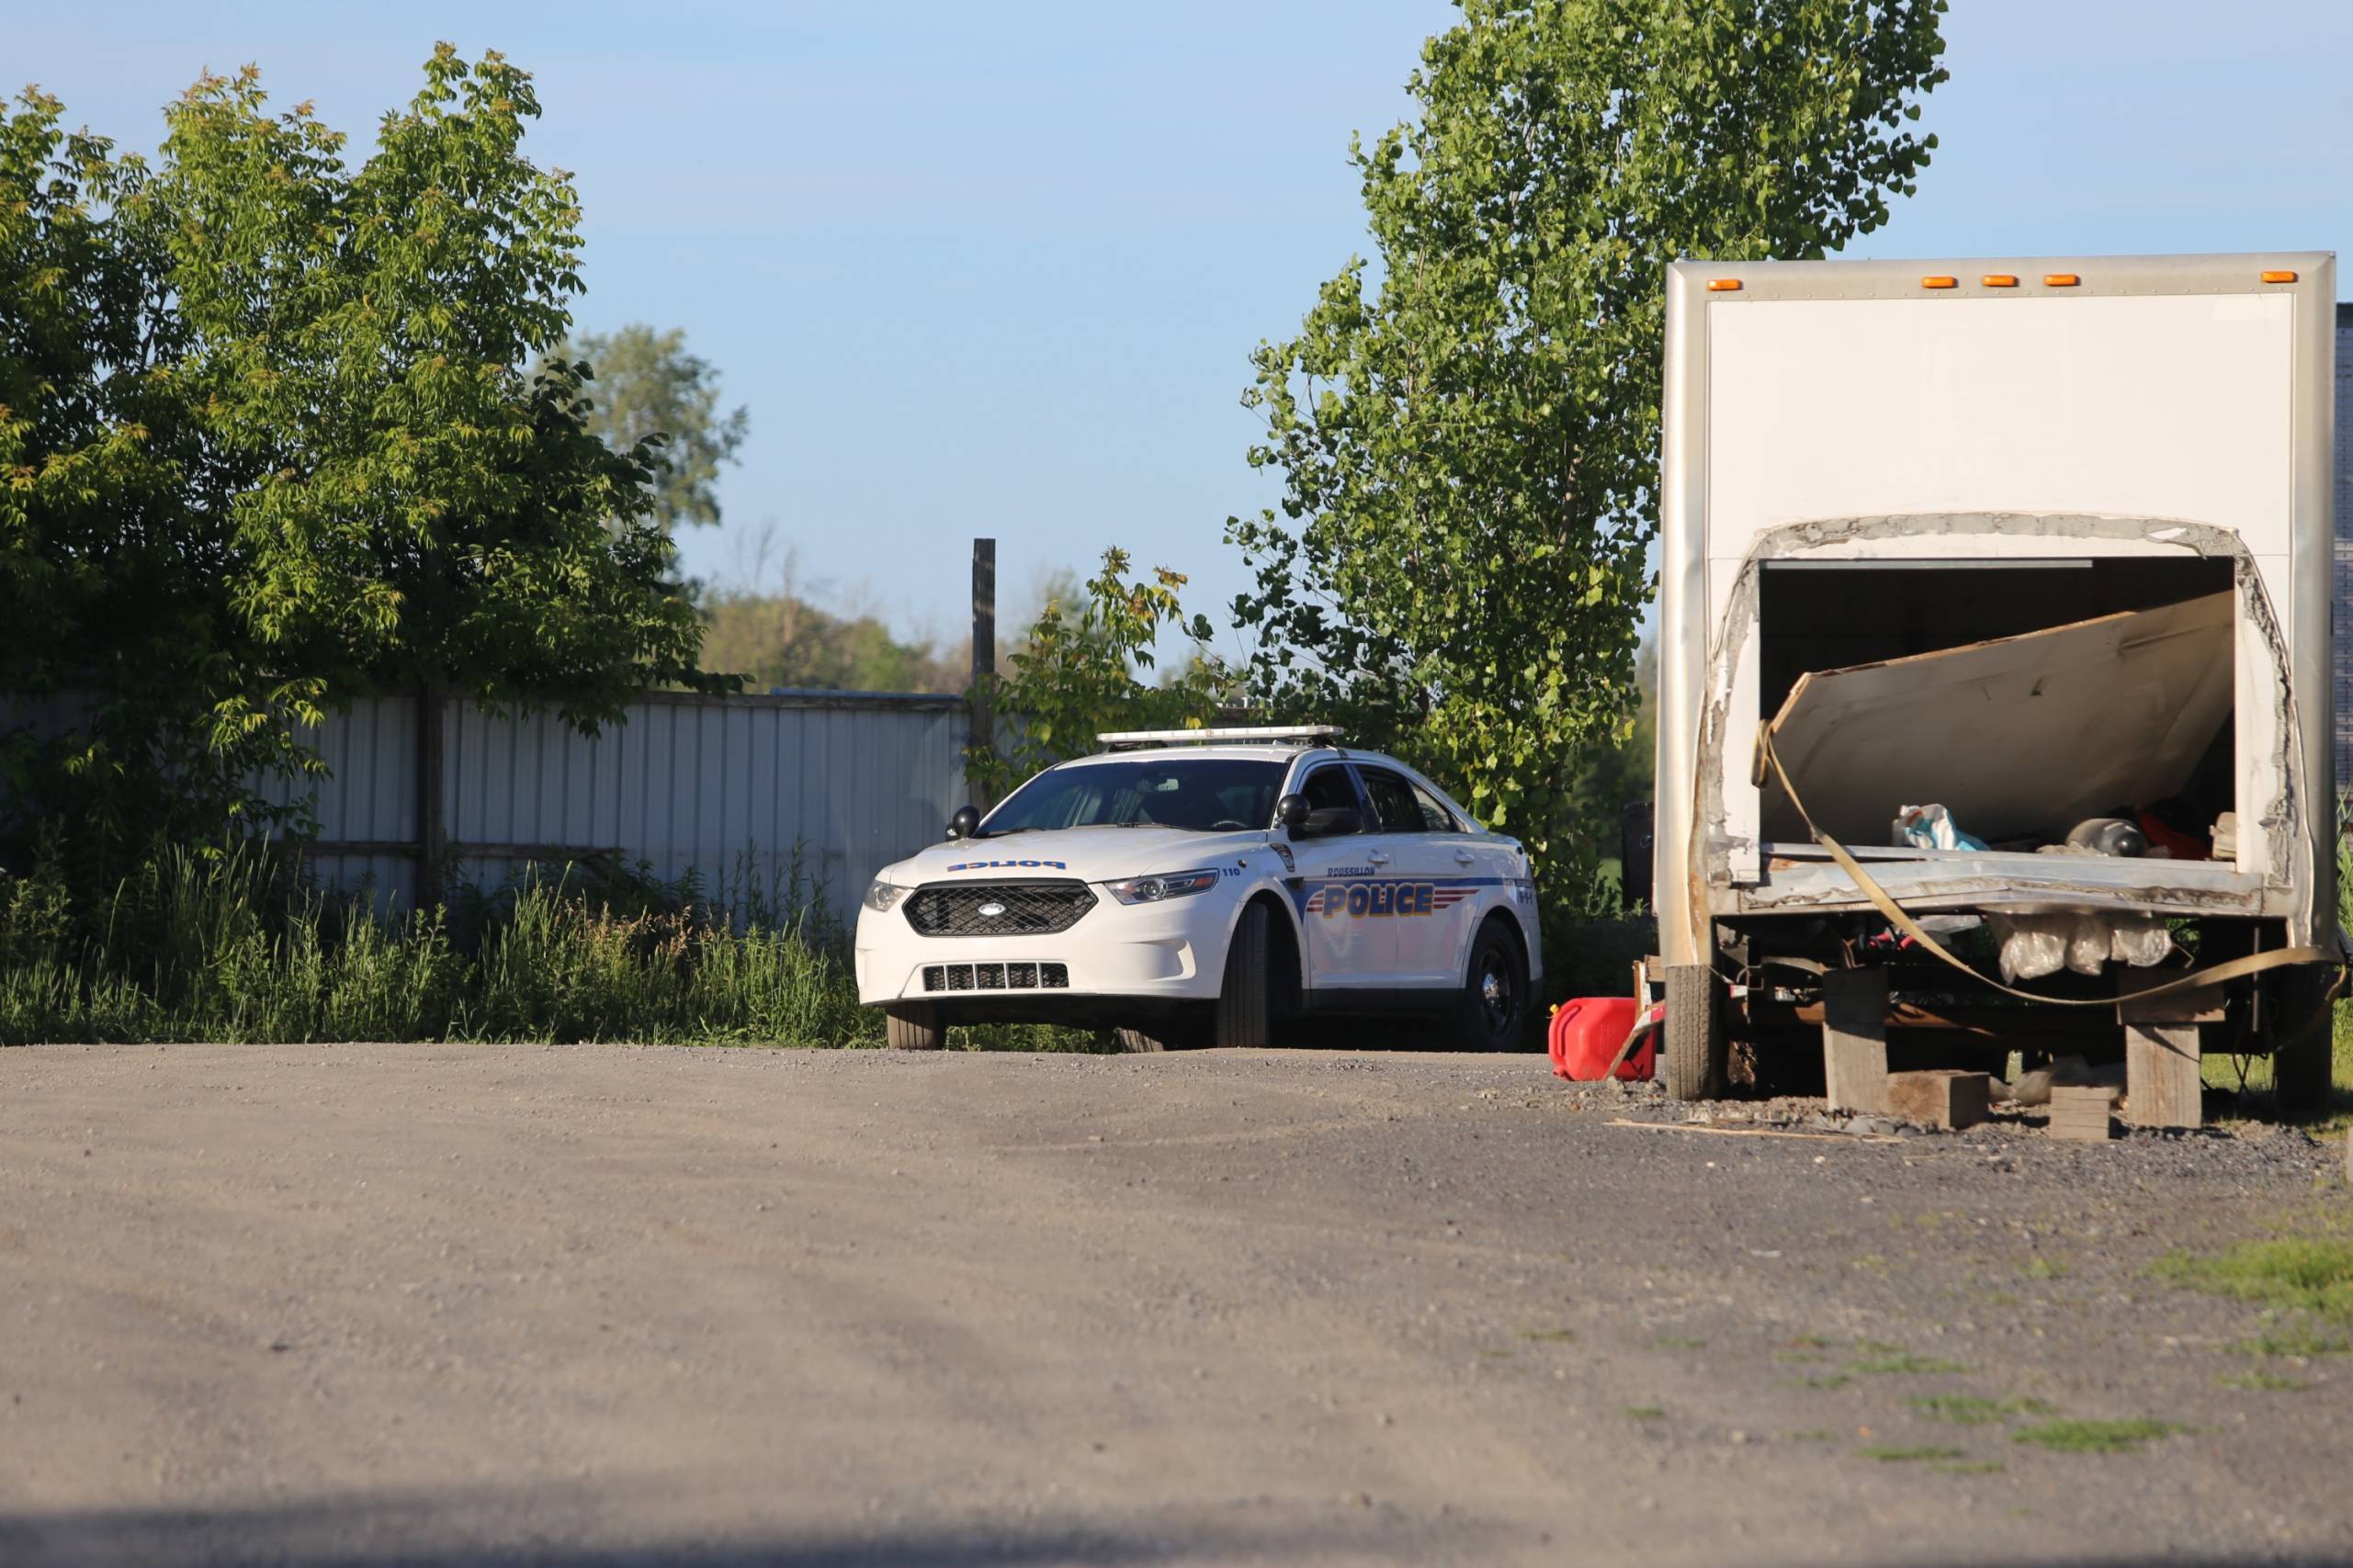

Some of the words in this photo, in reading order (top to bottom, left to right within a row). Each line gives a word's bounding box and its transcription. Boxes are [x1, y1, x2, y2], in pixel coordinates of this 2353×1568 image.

[1222, 868, 1240, 876] 110
[1328, 867, 1374, 877] ROUSSILLON
[1323, 883, 1435, 919] POLICE
